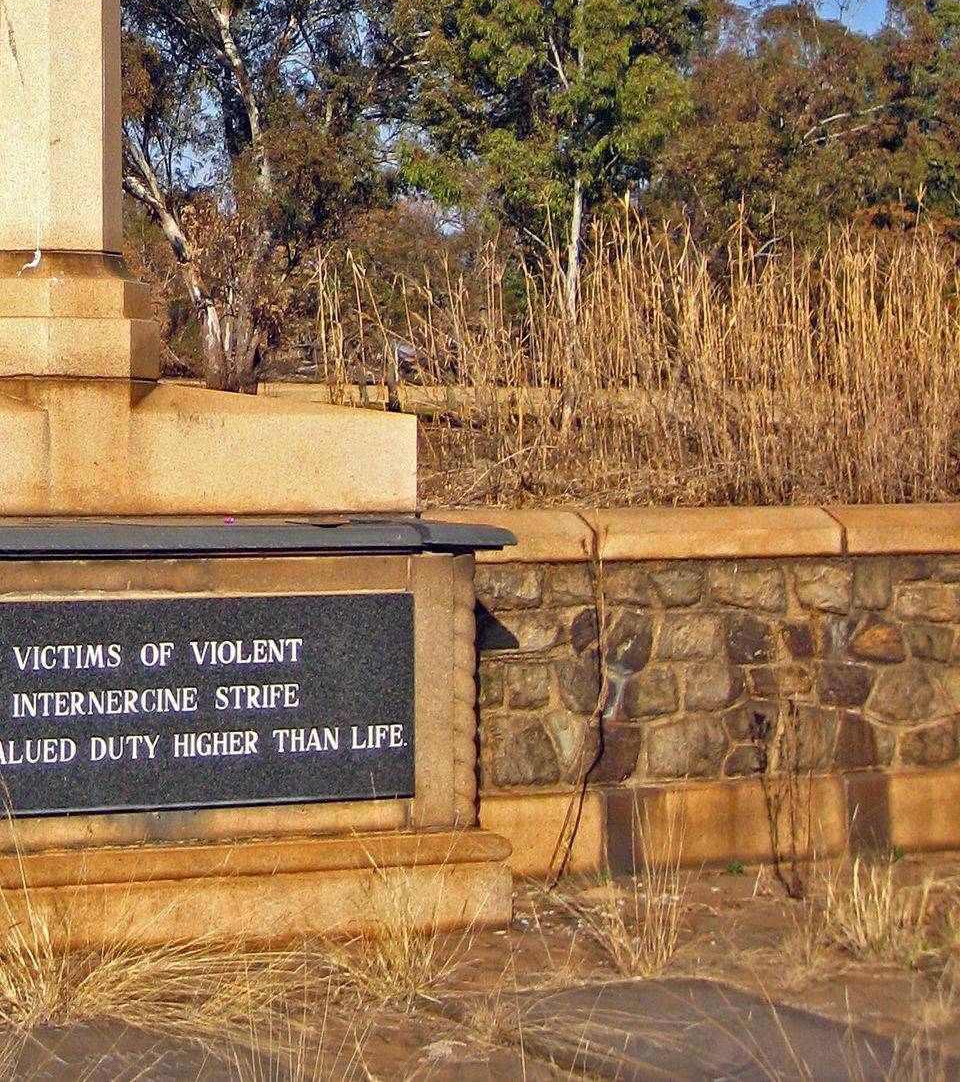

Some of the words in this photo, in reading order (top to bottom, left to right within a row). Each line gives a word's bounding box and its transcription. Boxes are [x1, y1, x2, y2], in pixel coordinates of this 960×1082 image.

[12, 643, 122, 671] VICTIMS
[139, 642, 175, 667] OF
[189, 638, 303, 666] VIOLENT
[12, 687, 198, 718] INTERNERCINE
[214, 683, 300, 711] STRIFE
[90, 734, 161, 762] DUTY
[173, 730, 260, 758] HIGHER
[272, 726, 340, 753] THAN
[351, 724, 408, 750] LIFE.
